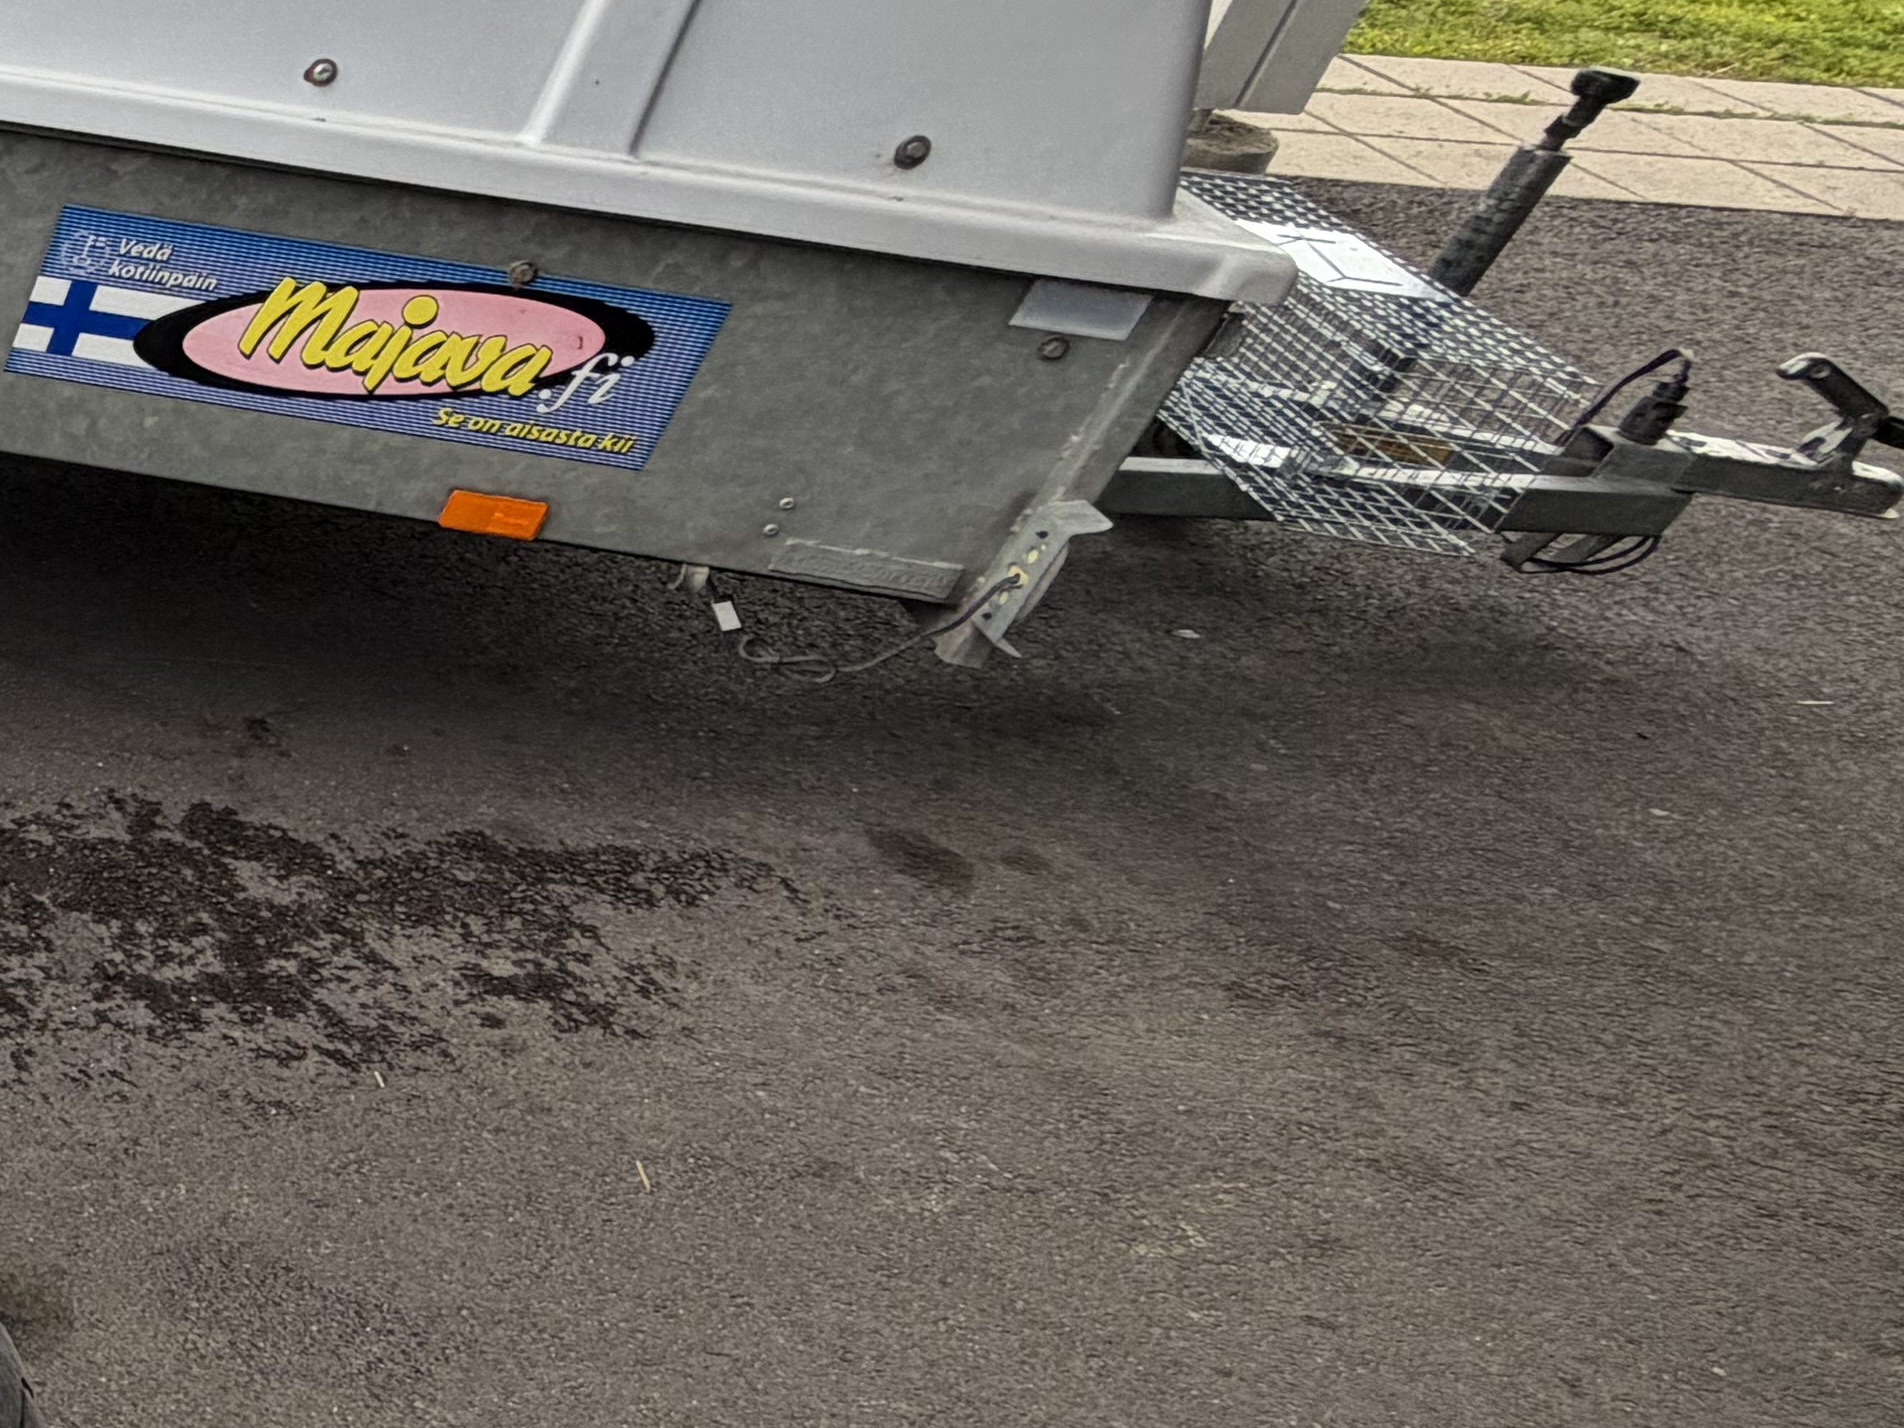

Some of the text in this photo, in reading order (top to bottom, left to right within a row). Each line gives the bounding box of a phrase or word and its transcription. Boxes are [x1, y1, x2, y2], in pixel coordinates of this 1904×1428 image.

[118, 238, 174, 261] Vedä
[432, 407, 638, 455] Se on aisasta kii
